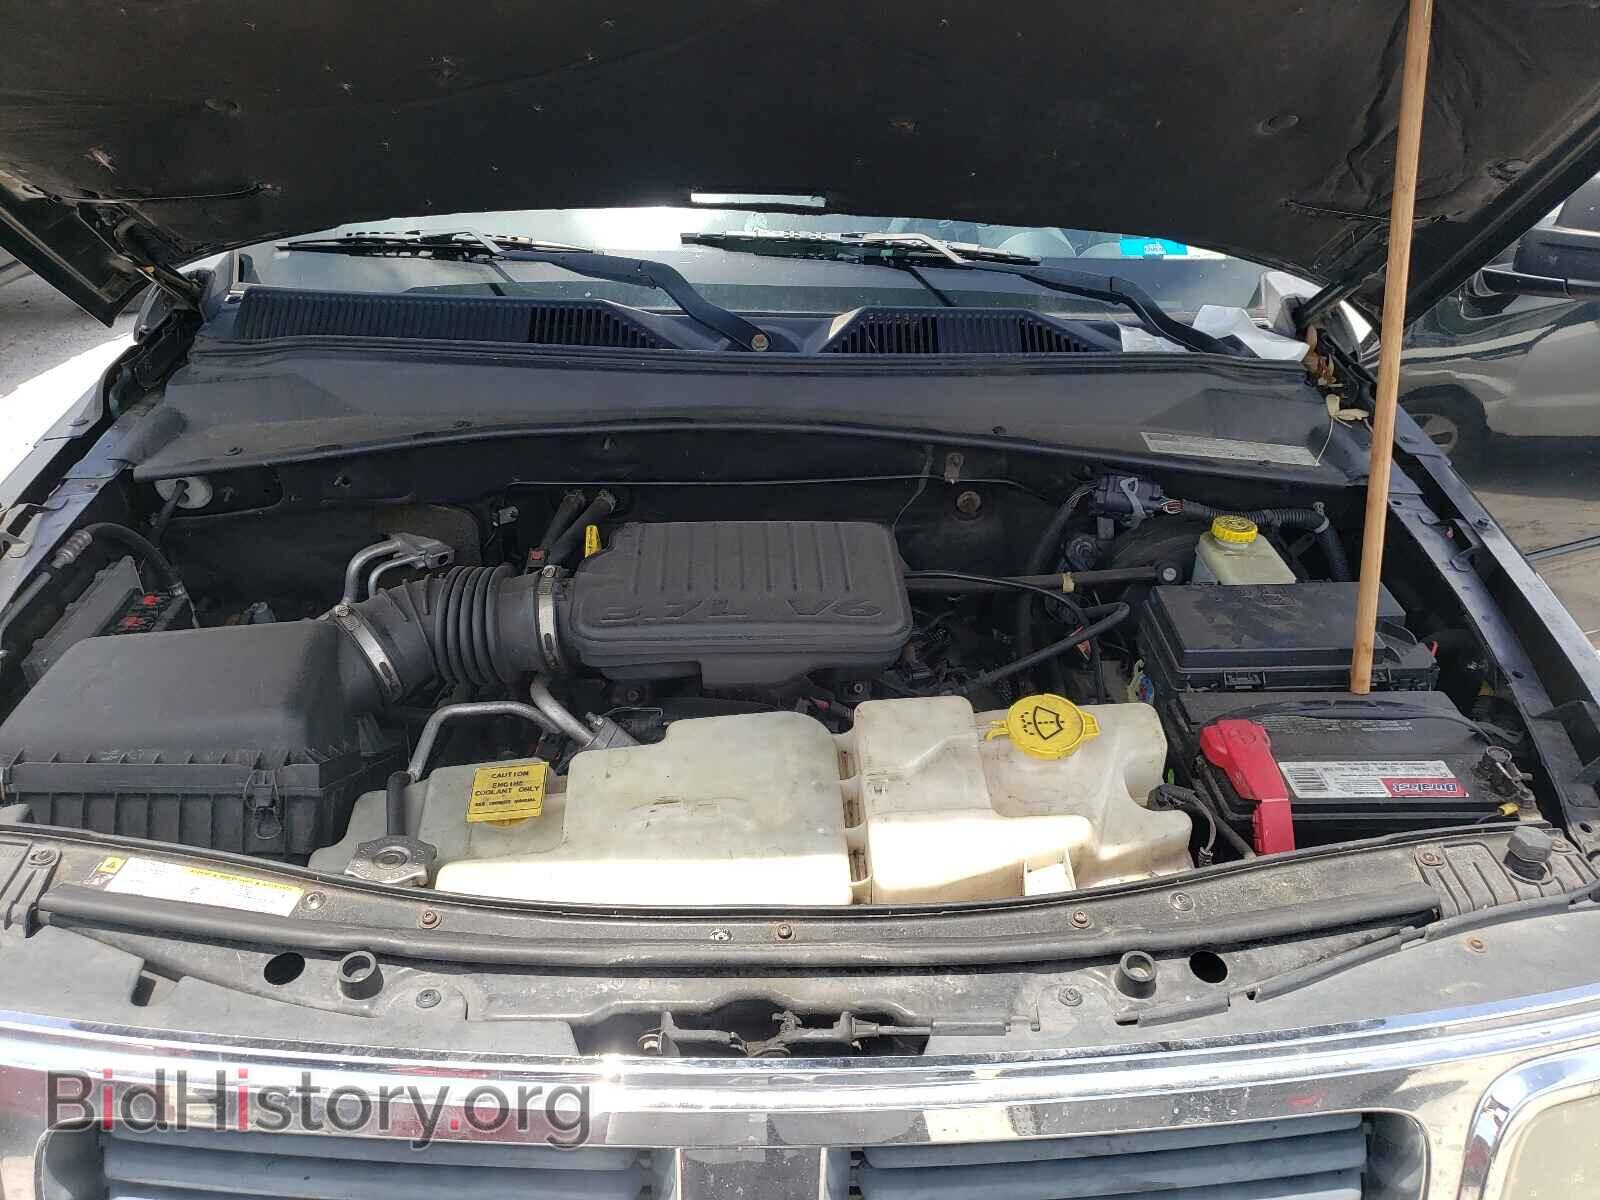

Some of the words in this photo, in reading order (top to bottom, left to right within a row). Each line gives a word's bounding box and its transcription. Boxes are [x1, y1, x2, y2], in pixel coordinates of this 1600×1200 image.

[785, 599, 884, 618] V6
[475, 788, 512, 796] COOLANT
[1392, 783, 1457, 792] Duralast
